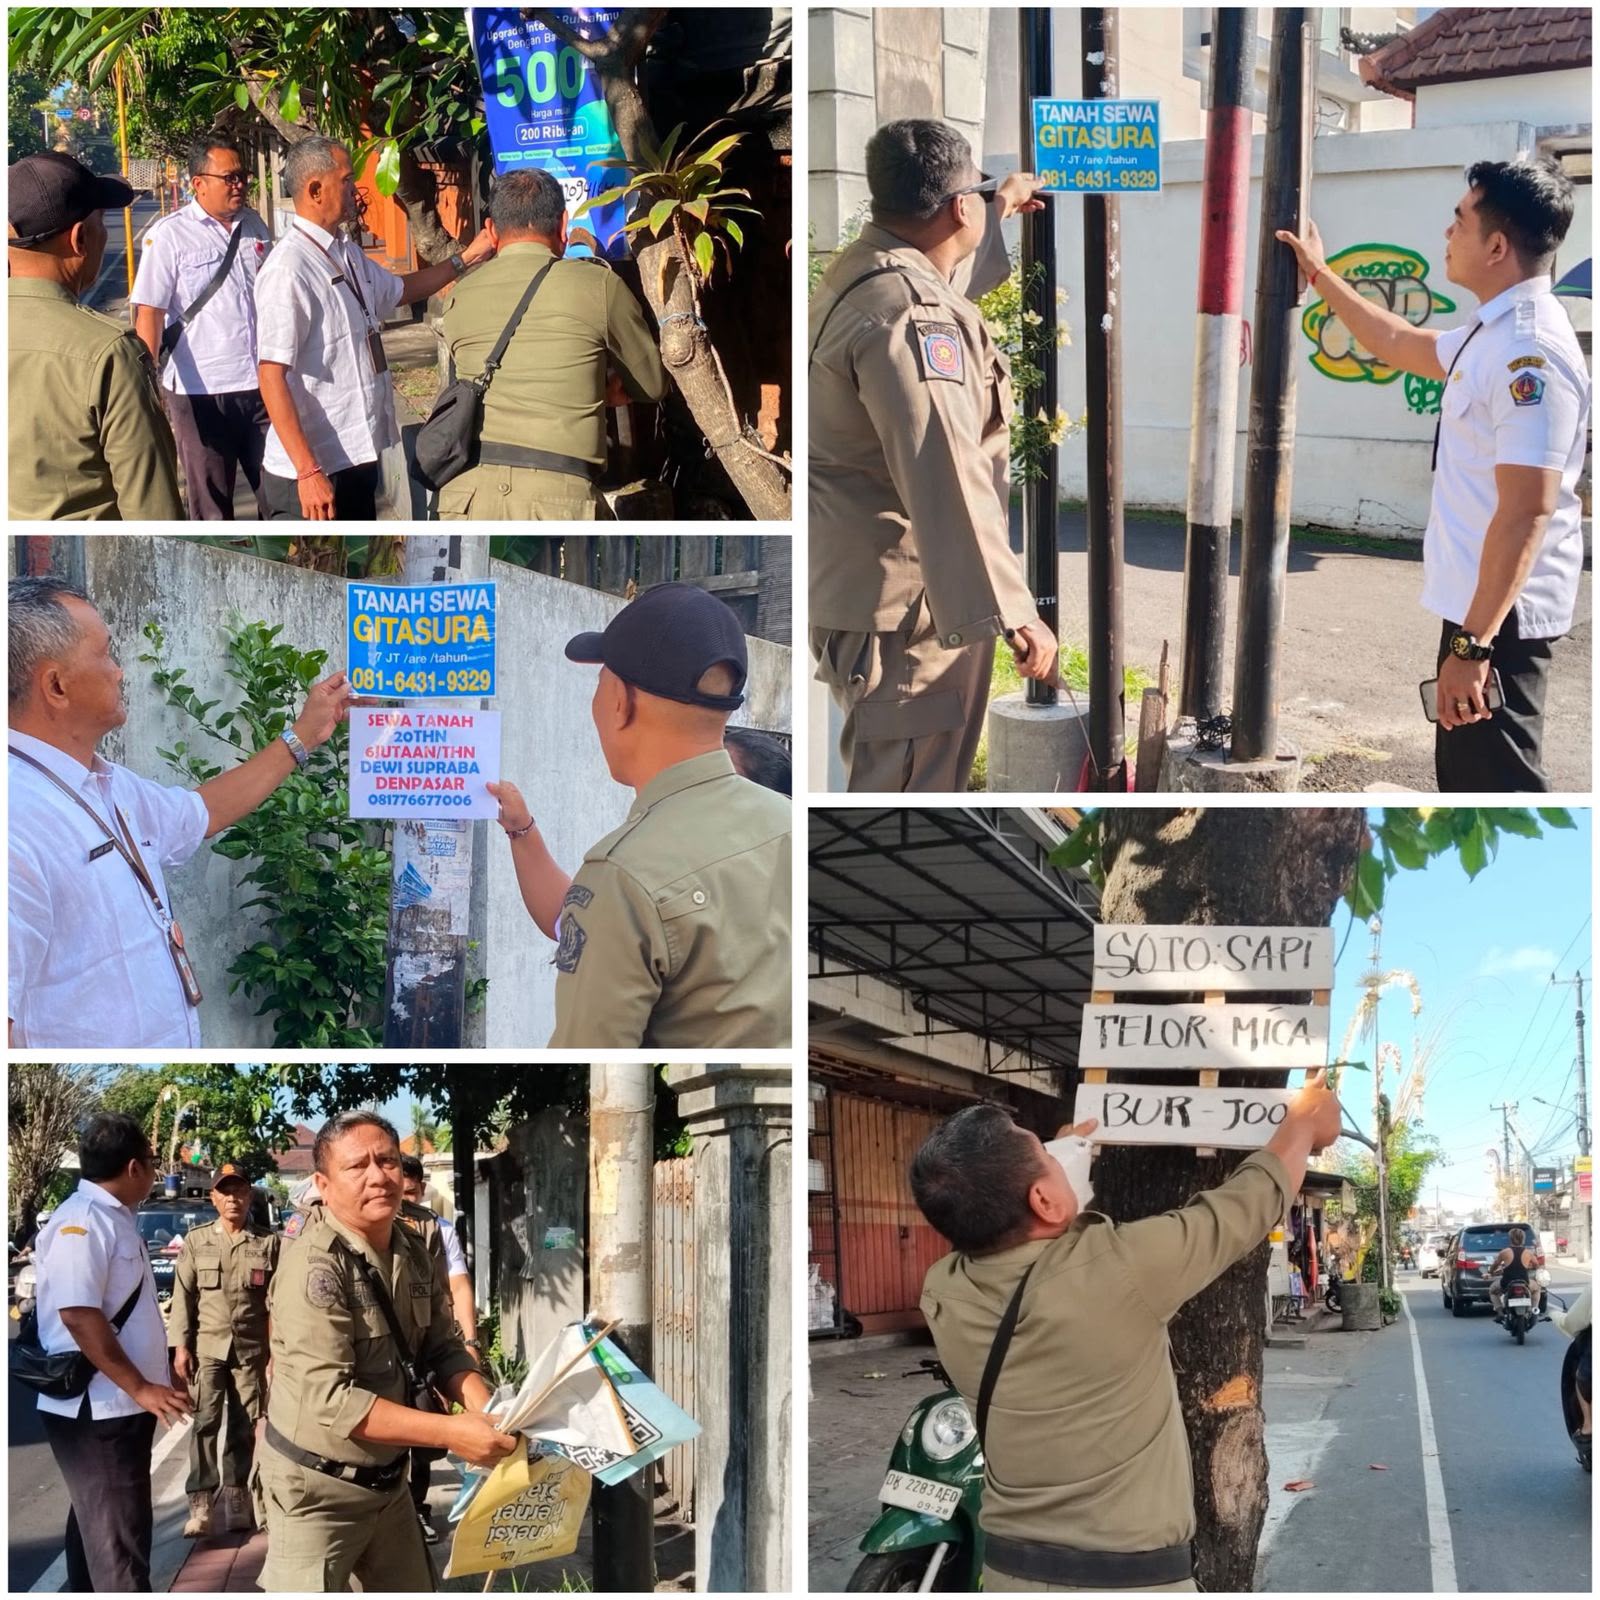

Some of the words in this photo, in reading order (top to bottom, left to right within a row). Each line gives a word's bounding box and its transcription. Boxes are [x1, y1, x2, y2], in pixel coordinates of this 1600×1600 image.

[496, 46, 586, 108] 500
[1038, 104, 1099, 123] TANAH
[1102, 104, 1156, 123] SEWA
[520, 127, 540, 141] 200
[542, 124, 584, 139] Ribu-an
[1039, 125, 1156, 149] GITASURA
[1059, 154, 1065, 164] 7
[1068, 155, 1080, 164] JT
[1105, 155, 1138, 165] /tahun
[1040, 169, 1157, 188] 081-6431-9329
[353, 589, 425, 614] TANAH
[429, 588, 491, 612] SEWA
[353, 614, 491, 646] GITASURA
[375, 652, 382, 663] 7
[385, 653, 401, 664] JT
[403, 653, 427, 665] /are
[430, 651, 468, 664] /tahun
[352, 667, 491, 693] 081-6431-9329
[368, 713, 412, 728] SEWA
[416, 714, 474, 728] TANAH
[393, 729, 448, 744] 20THN
[364, 745, 476, 760] 6JUTAAN/THN
[360, 760, 403, 774] DEWI
[407, 761, 481, 775] SUPRABA
[375, 776, 465, 791] DENPASAR
[367, 793, 472, 807] 081776677006
[886, 1473, 903, 1490] DK
[905, 1478, 936, 1496] 2283
